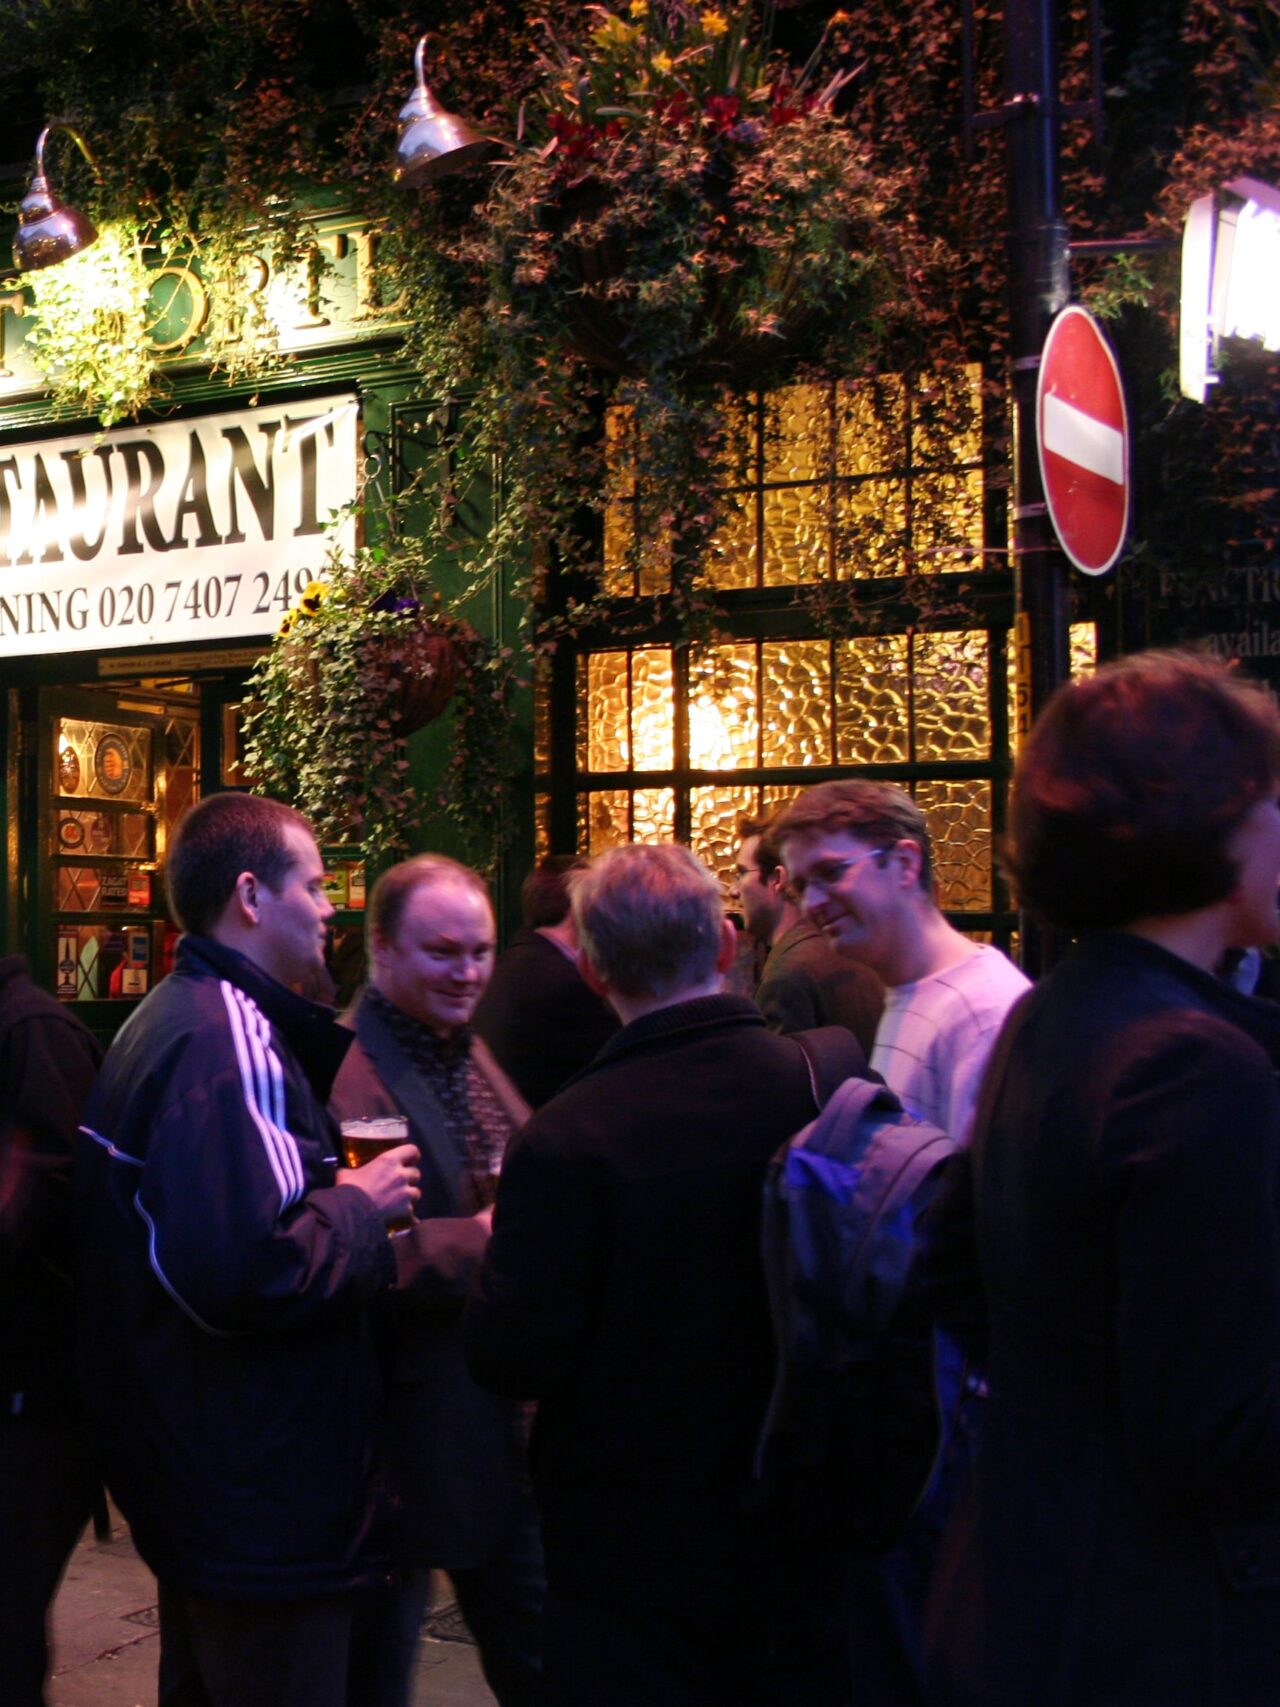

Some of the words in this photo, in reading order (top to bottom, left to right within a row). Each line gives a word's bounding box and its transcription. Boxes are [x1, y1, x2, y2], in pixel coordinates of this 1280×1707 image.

[99, 582, 155, 628] 020
[165, 574, 243, 624] 7407
[252, 566, 320, 615] 249
